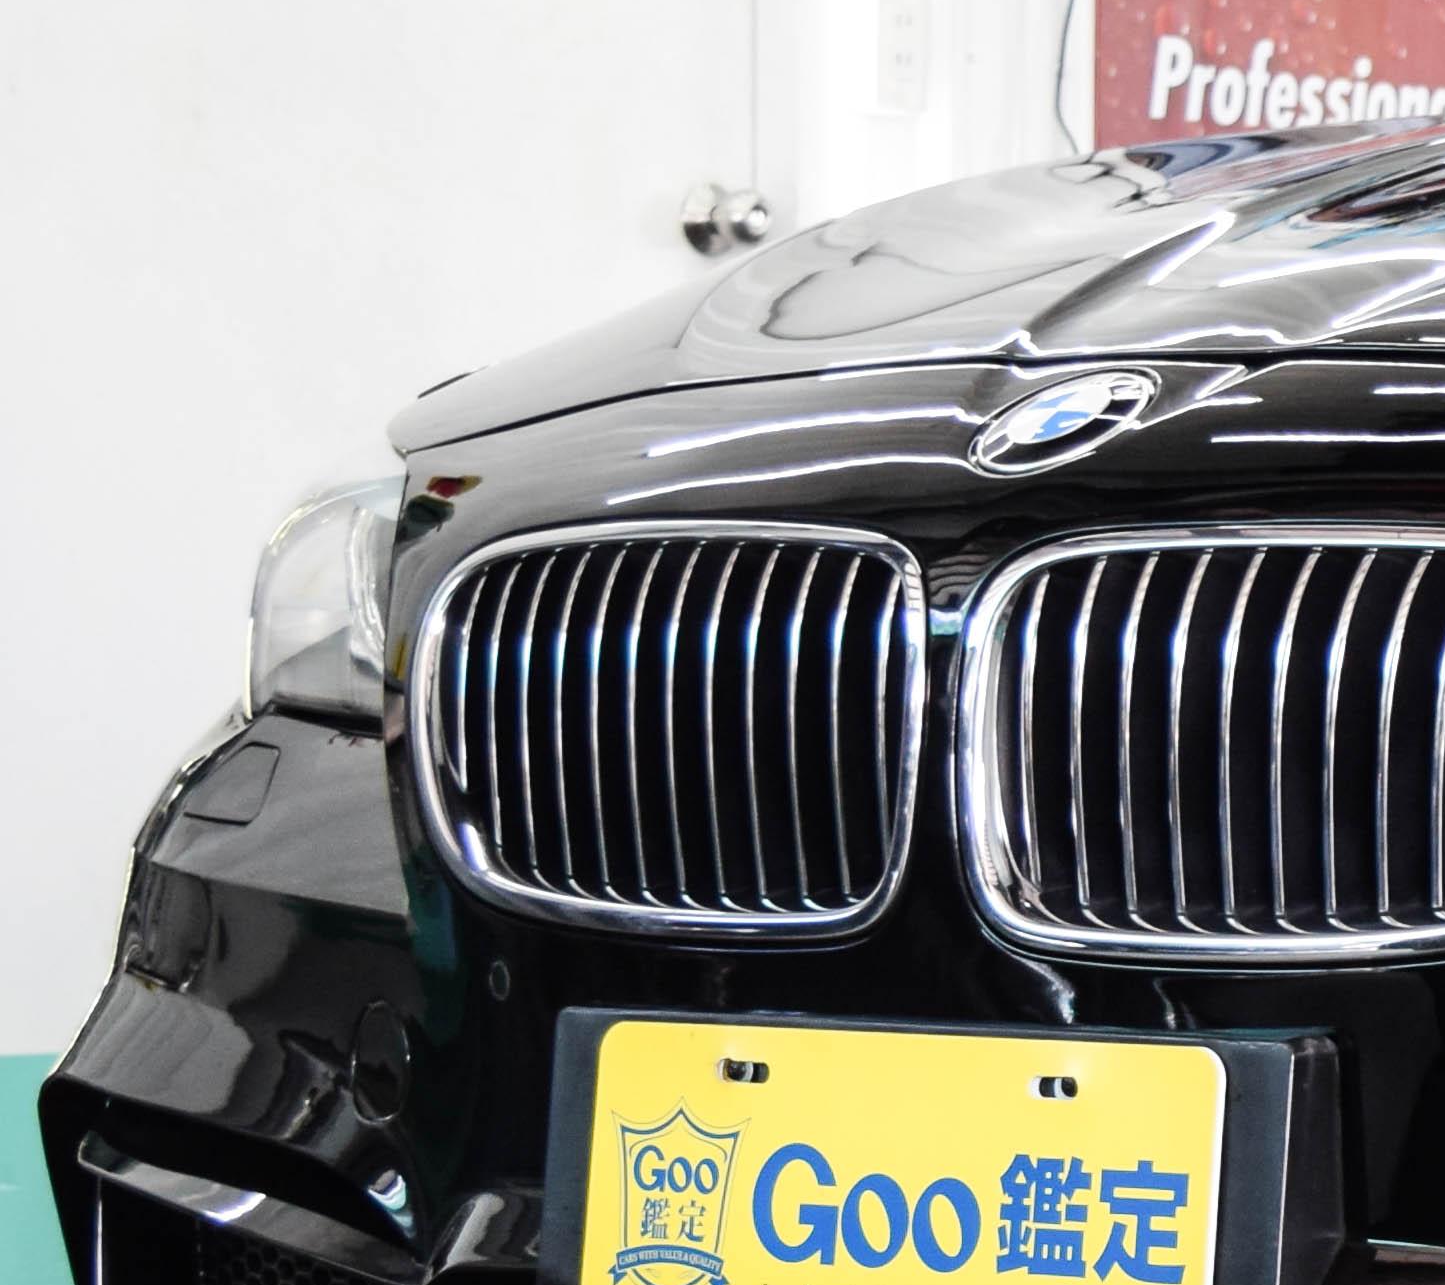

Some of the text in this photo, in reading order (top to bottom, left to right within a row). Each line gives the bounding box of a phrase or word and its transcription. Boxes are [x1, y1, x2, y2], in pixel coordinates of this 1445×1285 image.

[633, 1144, 720, 1195] Goo
[640, 1197, 706, 1243] 鑑定
[752, 1142, 1190, 1285] Goo 鑑定
